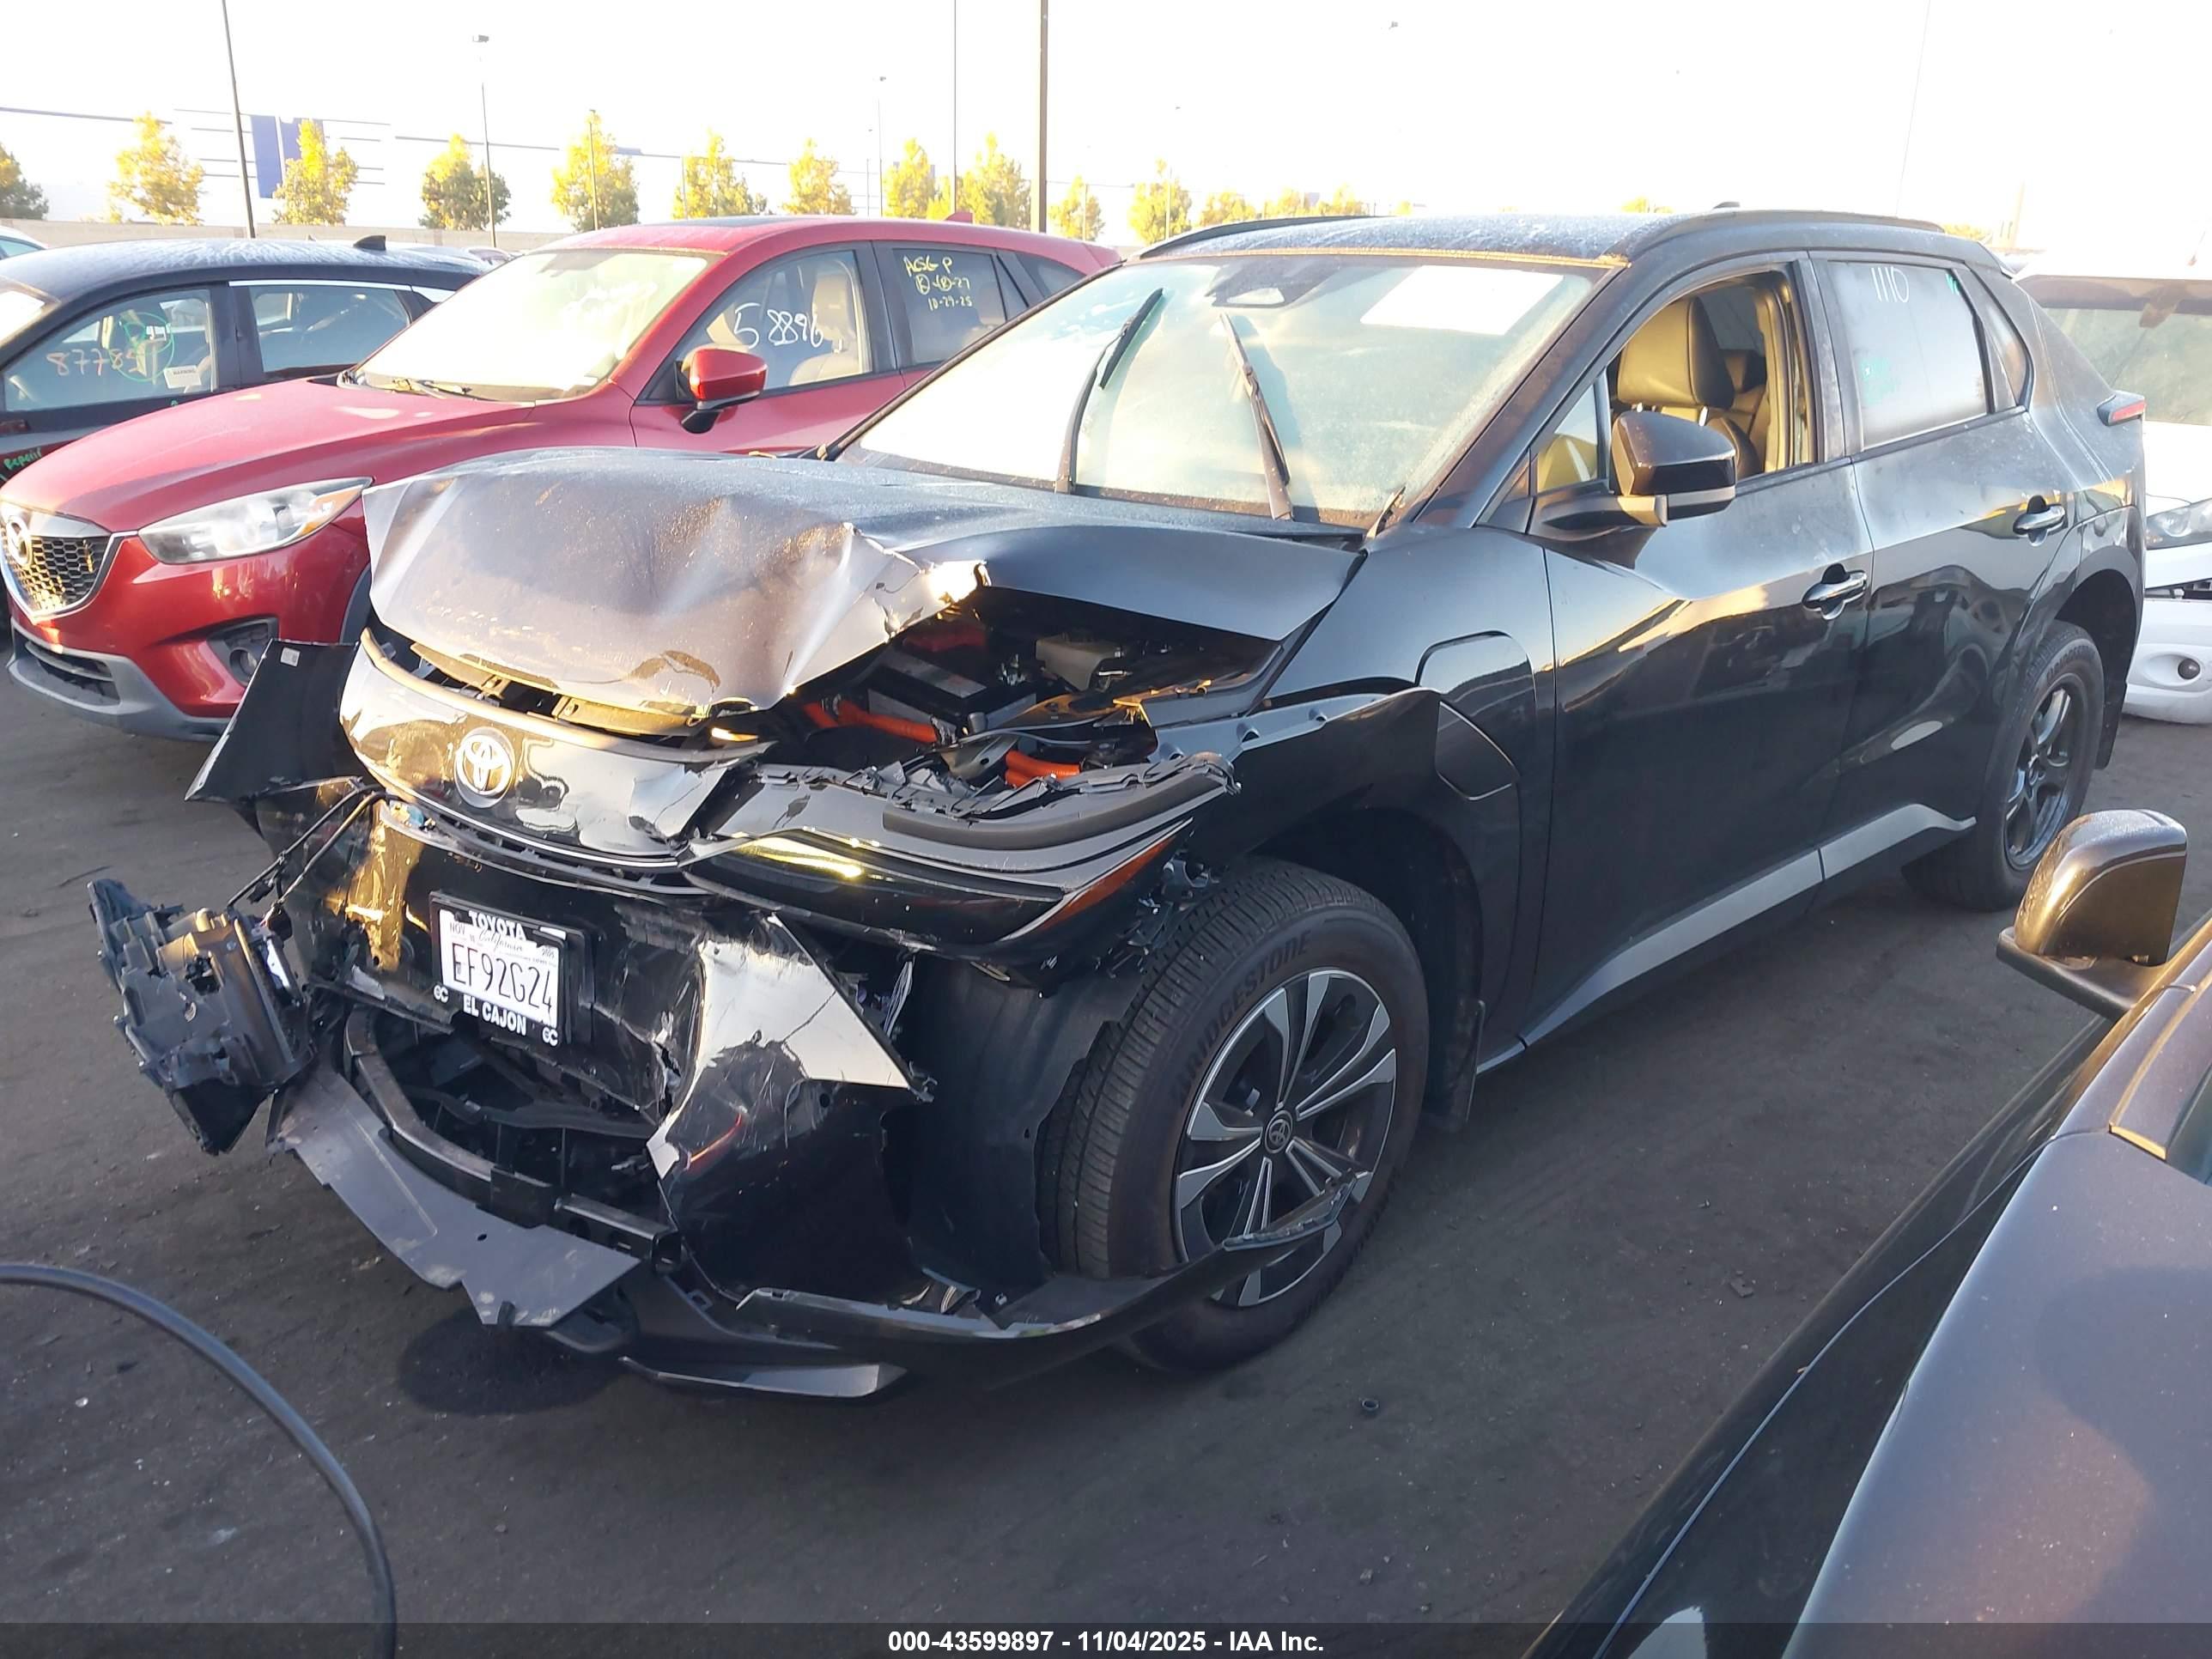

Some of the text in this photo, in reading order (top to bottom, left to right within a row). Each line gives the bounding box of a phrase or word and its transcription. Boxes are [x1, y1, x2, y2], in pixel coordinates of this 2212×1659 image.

[449, 921, 465, 935] NOV
[468, 910, 527, 941] TOYOTA
[452, 942, 552, 1011] EF92G24
[463, 994, 527, 1036] EL CAJON
